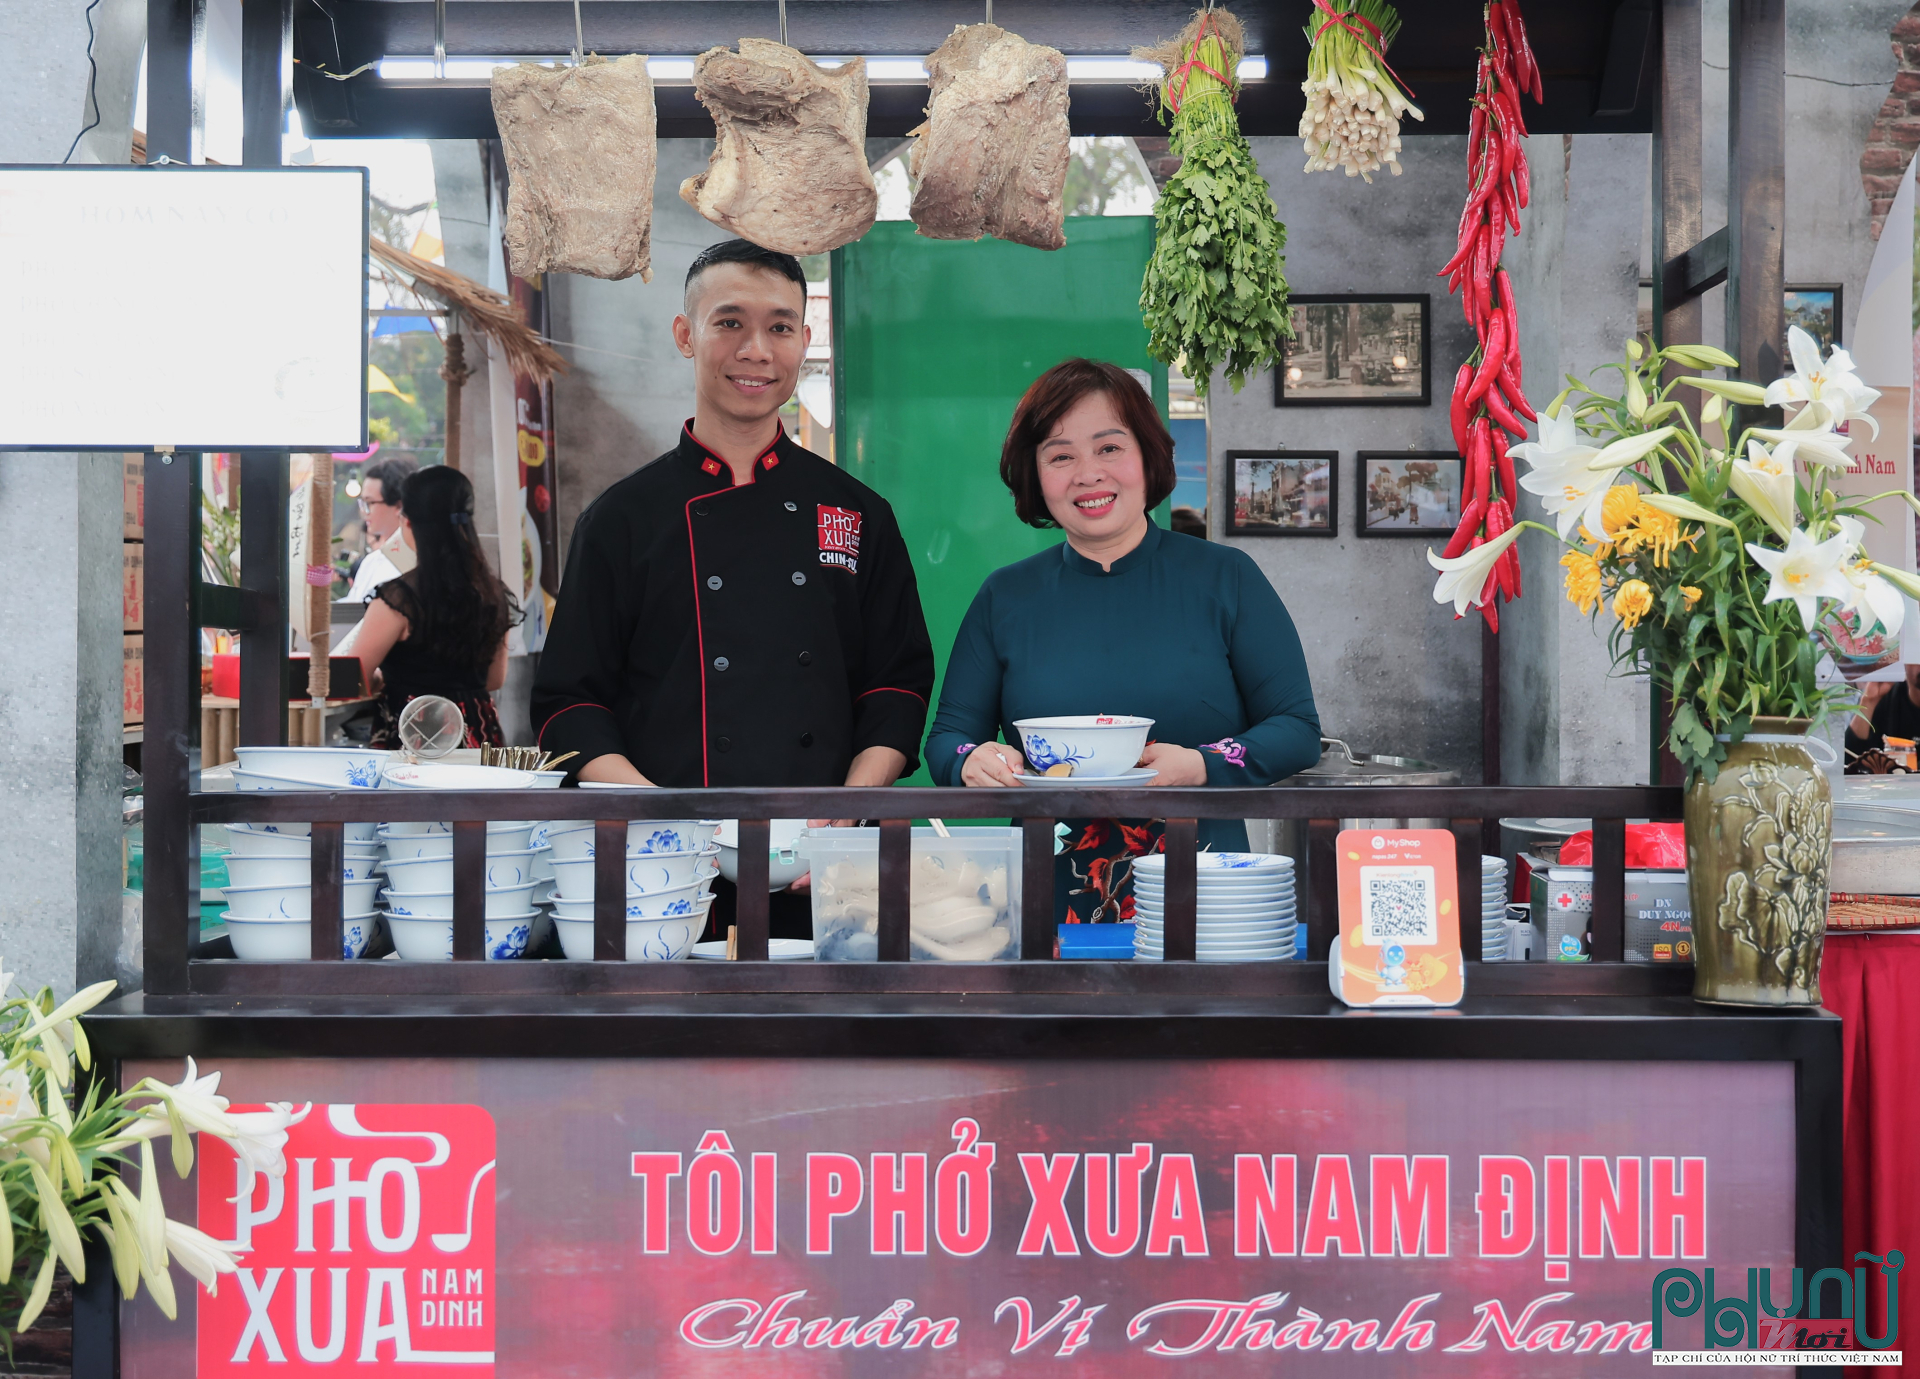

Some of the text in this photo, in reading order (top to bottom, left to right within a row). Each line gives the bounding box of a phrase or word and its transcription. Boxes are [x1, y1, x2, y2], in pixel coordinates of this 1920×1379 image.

[1865, 454, 1896, 474] Nam
[819, 552, 857, 573] CHIN-SU
[1387, 838, 1421, 848] MyShop
[1638, 910, 1662, 919] DUY
[632, 1117, 1706, 1281] TÔI PHỞ XƯA NAM ĐỊNH
[421, 1268, 483, 1294] NAM
[421, 1300, 483, 1327] DINH
[679, 1289, 1652, 1357] Chuẩn Vị Thành Nam
